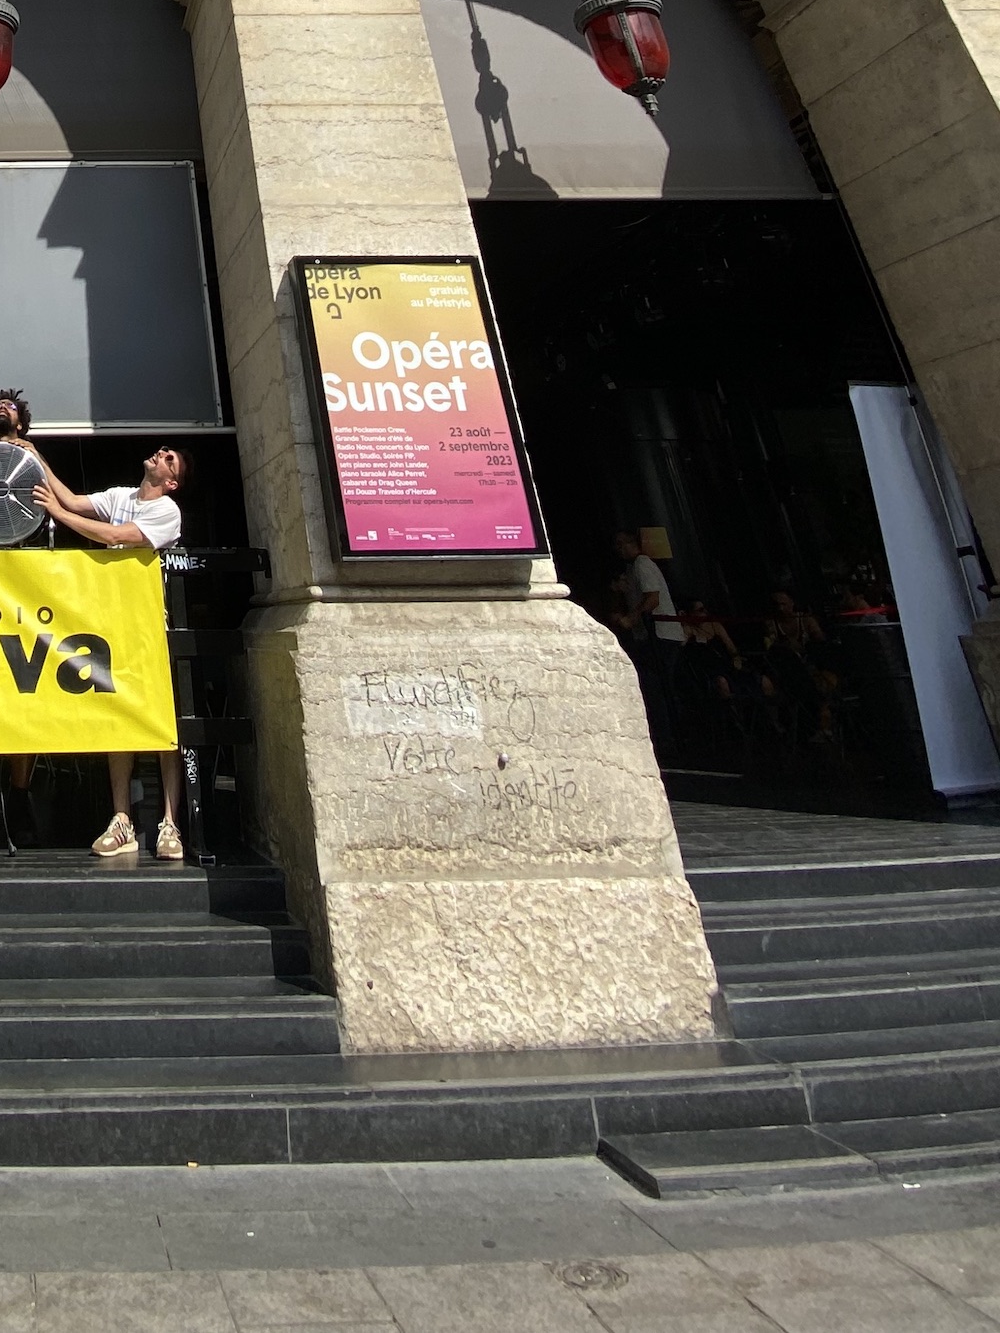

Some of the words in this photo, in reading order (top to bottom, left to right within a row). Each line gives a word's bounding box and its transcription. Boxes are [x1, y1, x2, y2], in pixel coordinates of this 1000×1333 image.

[399, 272, 466, 283] Rendez-vous
[334, 283, 382, 303] Lyon
[429, 286, 470, 297] gratuits
[426, 297, 472, 309] Péristyle
[352, 331, 495, 377] Opéra
[322, 372, 467, 412] Sunset
[449, 427, 463, 437] 23
[466, 427, 491, 437] août
[439, 441, 446, 451] 2
[449, 441, 510, 454] septembre
[486, 455, 513, 466] 2023
[341, 470, 359, 478] piano
[378, 479, 394, 487] Drag
[395, 479, 417, 487] Queen
[345, 498, 383, 506] Programme
